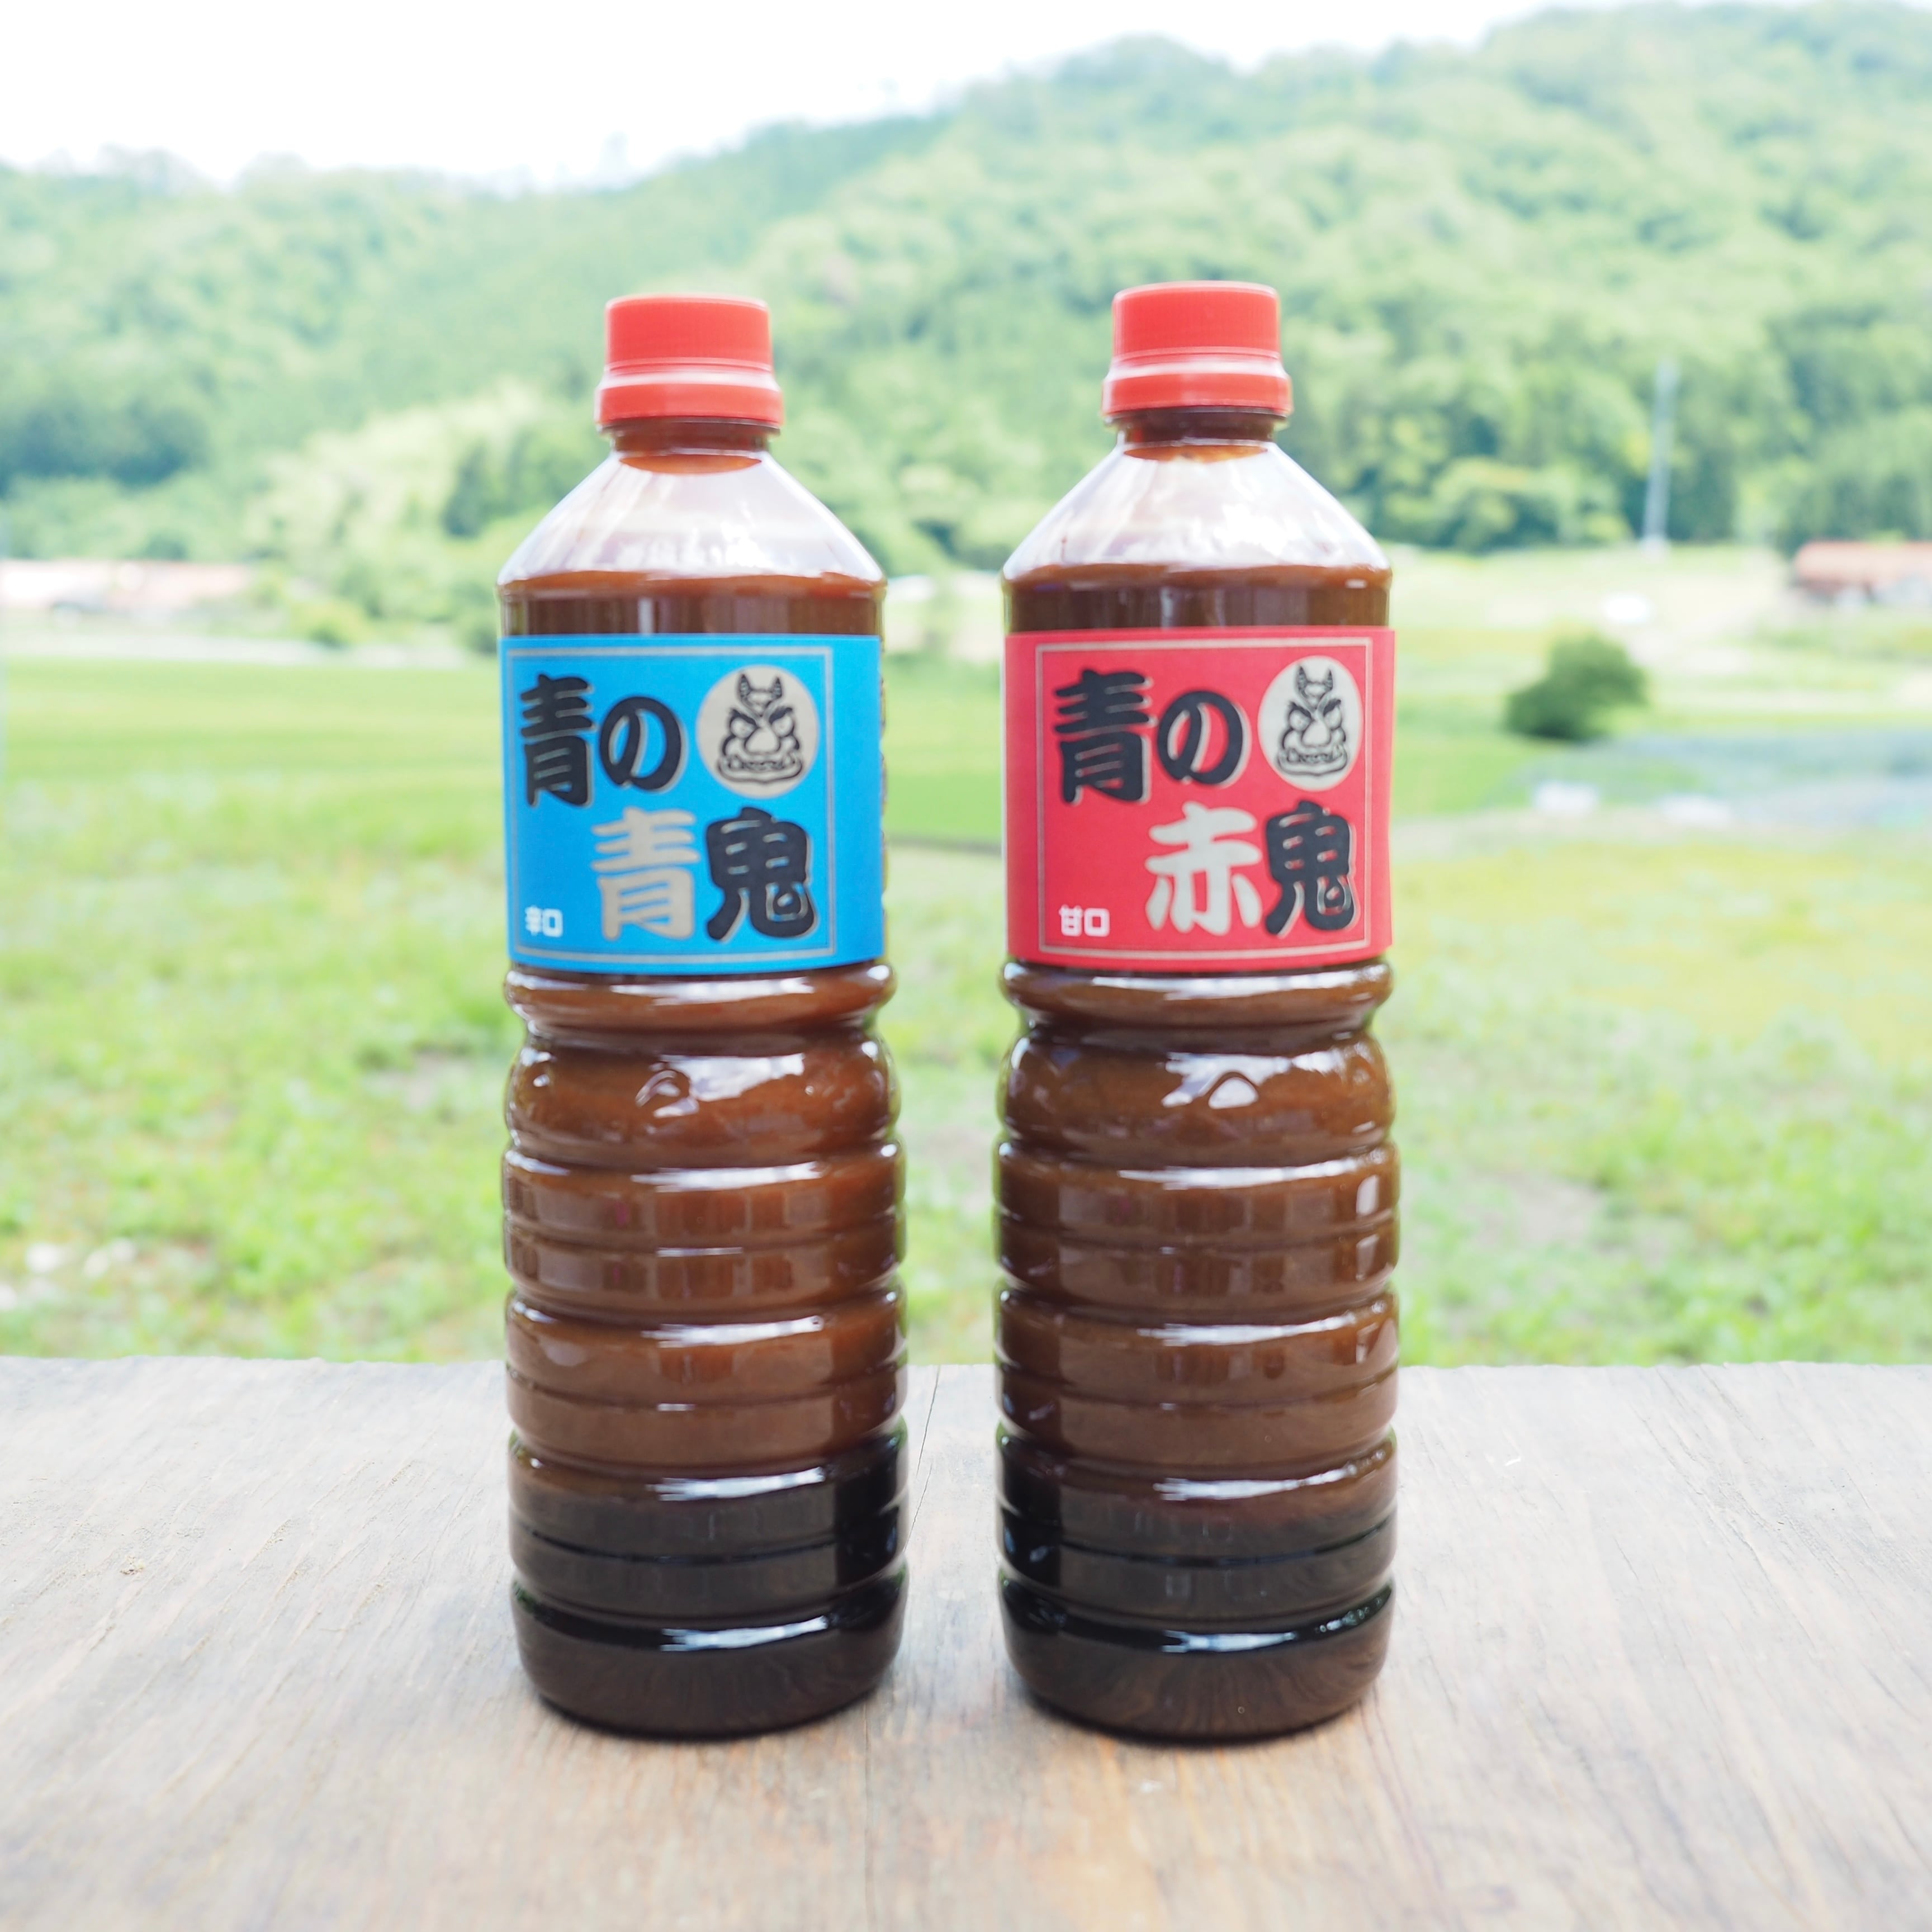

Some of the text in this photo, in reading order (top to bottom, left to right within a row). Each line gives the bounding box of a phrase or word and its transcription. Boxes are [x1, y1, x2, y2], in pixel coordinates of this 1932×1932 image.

[520, 674, 686, 807] 青の
[1054, 668, 1251, 805] 青の
[591, 806, 818, 942] 青鬼
[1059, 905, 1110, 937] 甘口
[1144, 800, 1360, 937] 赤鬼
